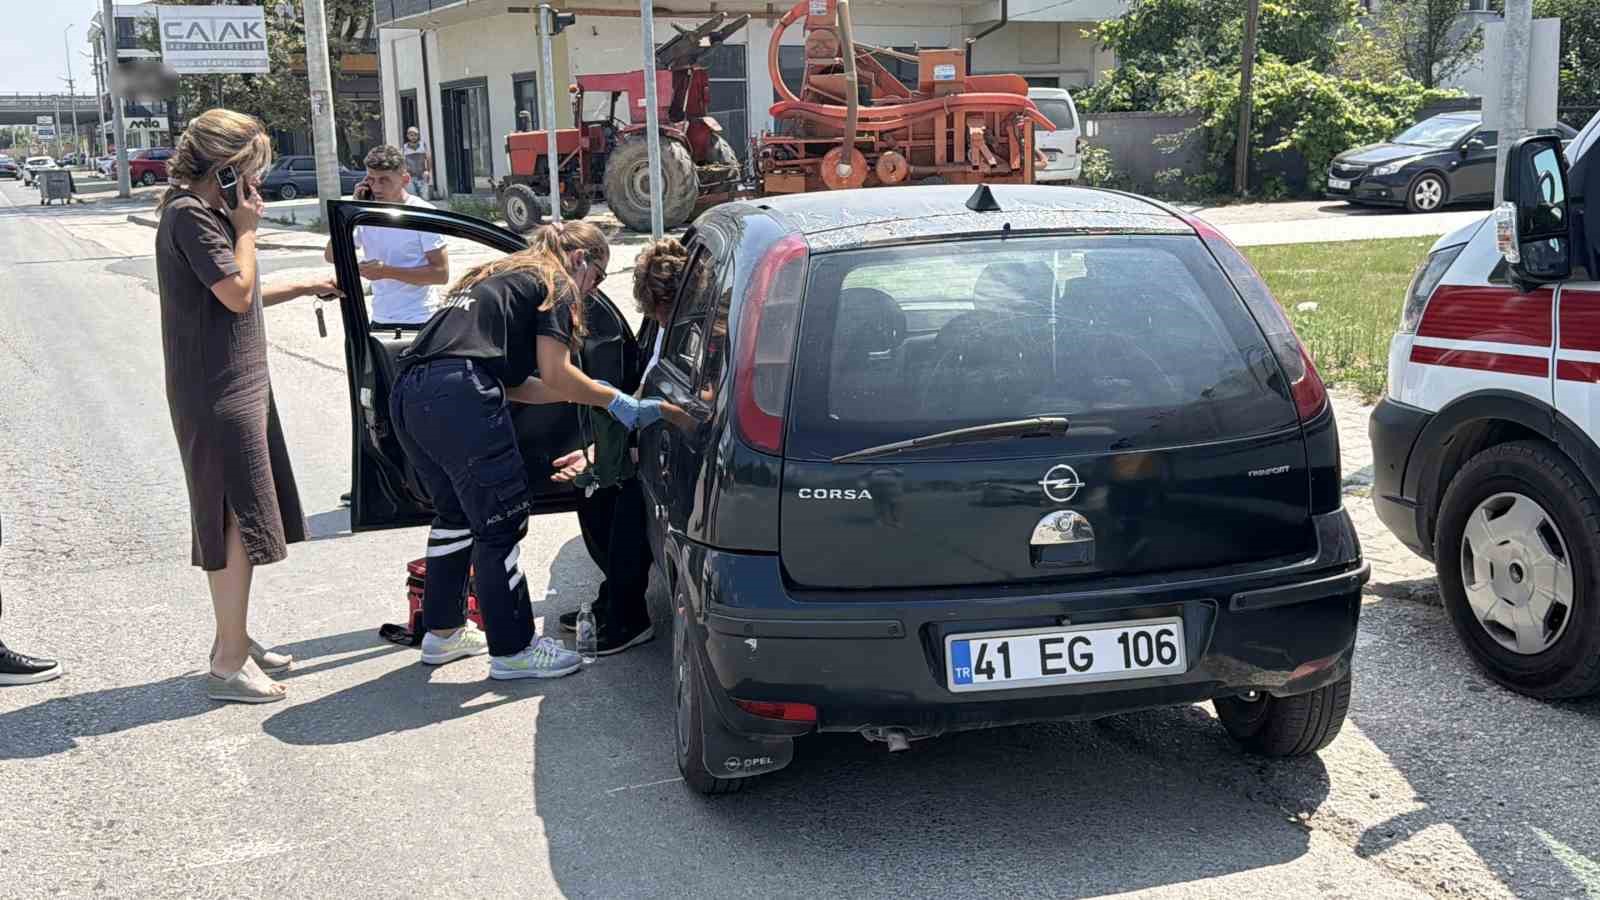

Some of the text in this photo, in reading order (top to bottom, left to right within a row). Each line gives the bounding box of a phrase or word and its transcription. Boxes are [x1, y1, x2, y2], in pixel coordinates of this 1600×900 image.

[798, 488, 873, 500] CORSA
[974, 628, 1178, 680] 41 EG 106
[955, 667, 971, 679] TR
[743, 756, 774, 767] OPEL
